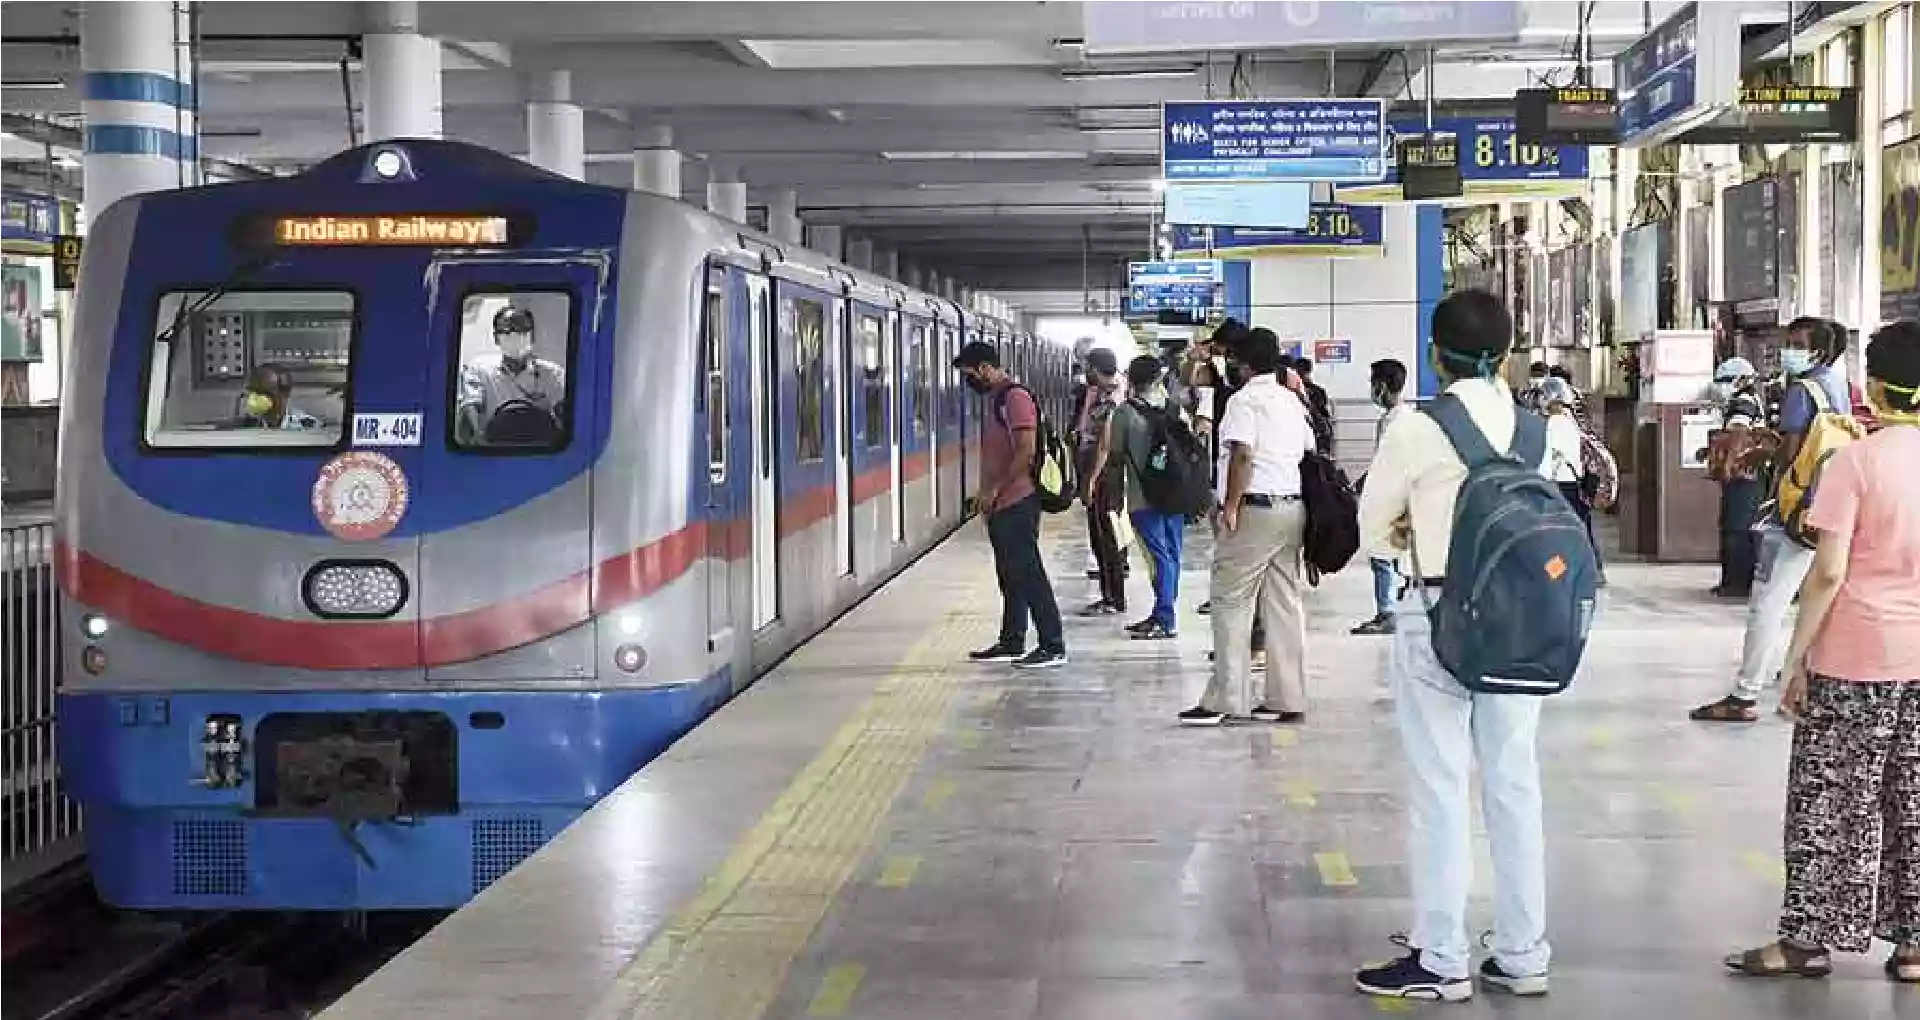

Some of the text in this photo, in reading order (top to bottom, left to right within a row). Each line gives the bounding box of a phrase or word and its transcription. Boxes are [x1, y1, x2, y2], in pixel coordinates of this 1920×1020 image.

[284, 216, 369, 241] Indian
[356, 417, 380, 440] MR
[391, 417, 418, 440] 404
